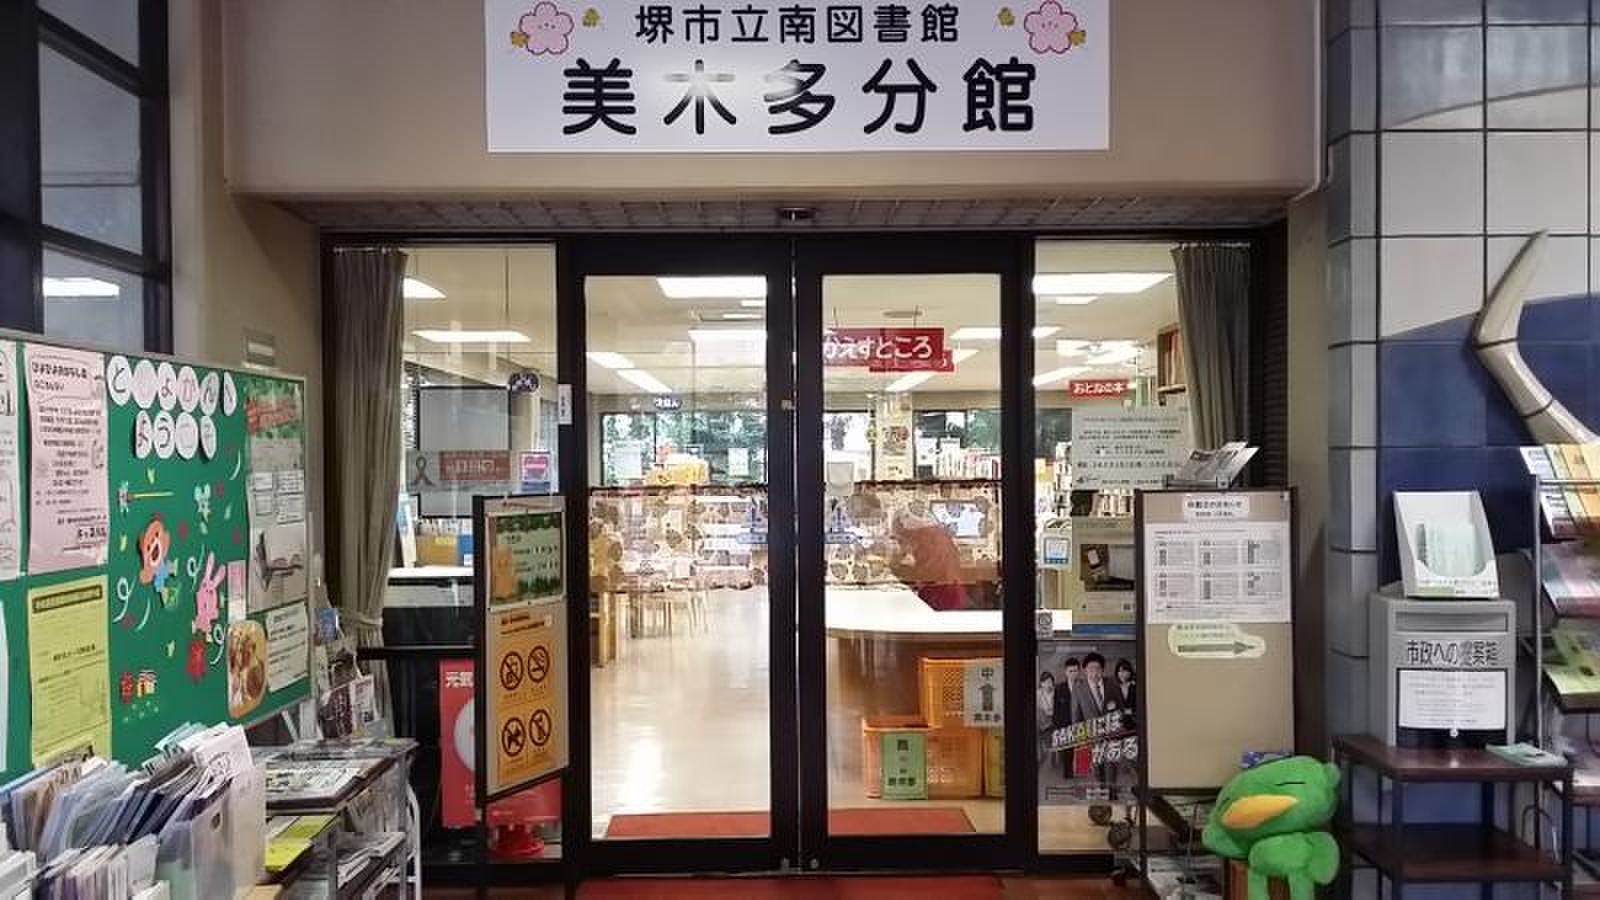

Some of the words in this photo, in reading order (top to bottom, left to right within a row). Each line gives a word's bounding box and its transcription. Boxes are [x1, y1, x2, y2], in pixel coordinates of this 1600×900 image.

[635, 4, 960, 43] 堺市立南図書館
[562, 57, 1036, 135] 美木多分館
